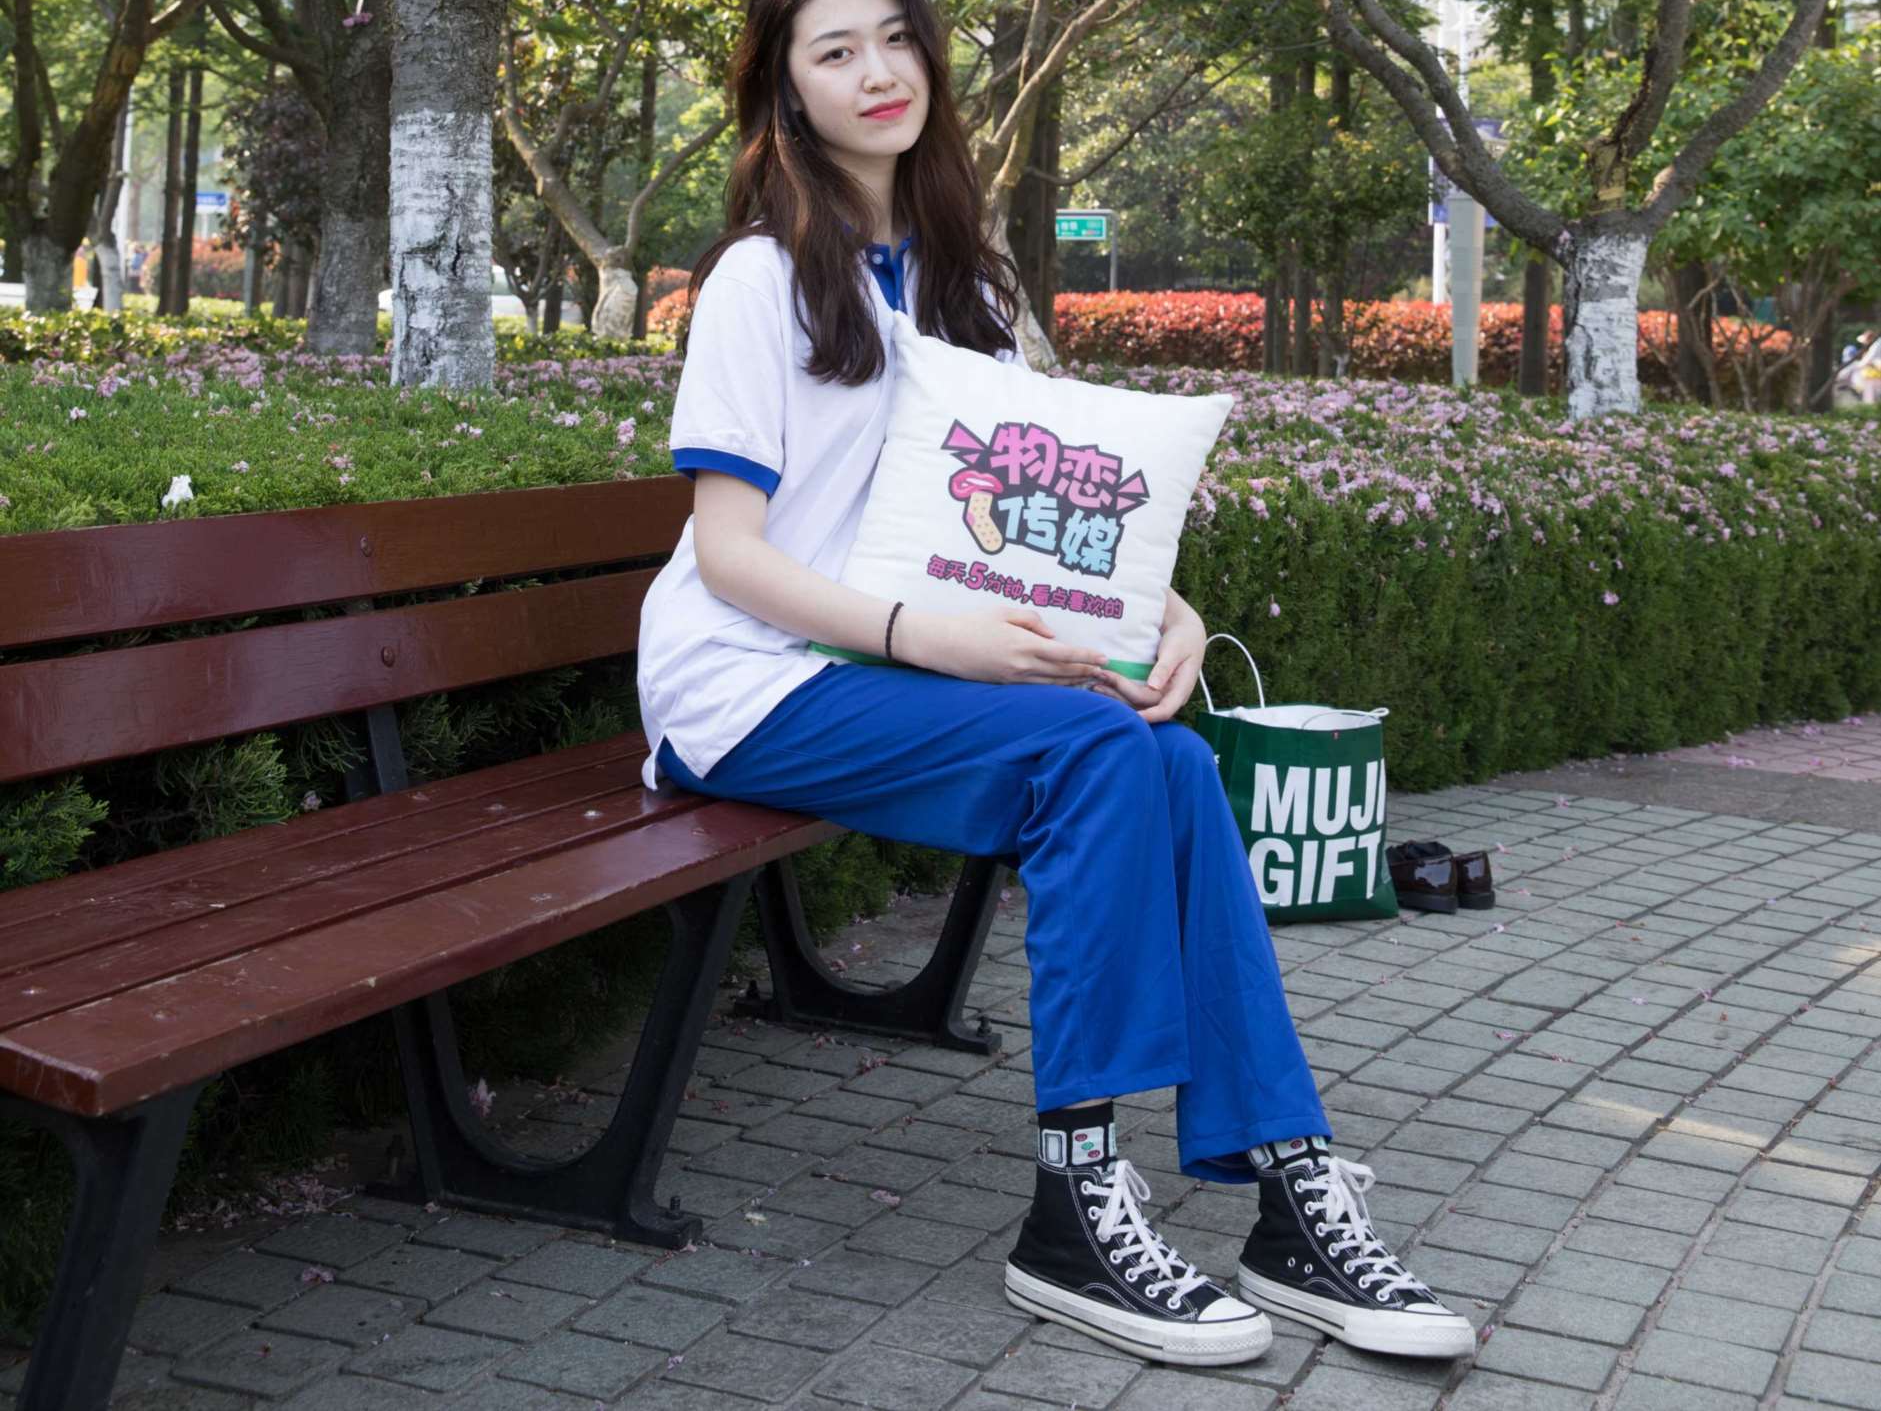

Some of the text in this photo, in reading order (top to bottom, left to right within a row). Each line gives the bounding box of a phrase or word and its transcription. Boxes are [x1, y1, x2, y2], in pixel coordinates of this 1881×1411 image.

[989, 423, 1120, 510] 物恋
[998, 491, 1121, 575] 传媒
[1250, 757, 1387, 836] MUJI
[1248, 829, 1382, 907] GIFT
